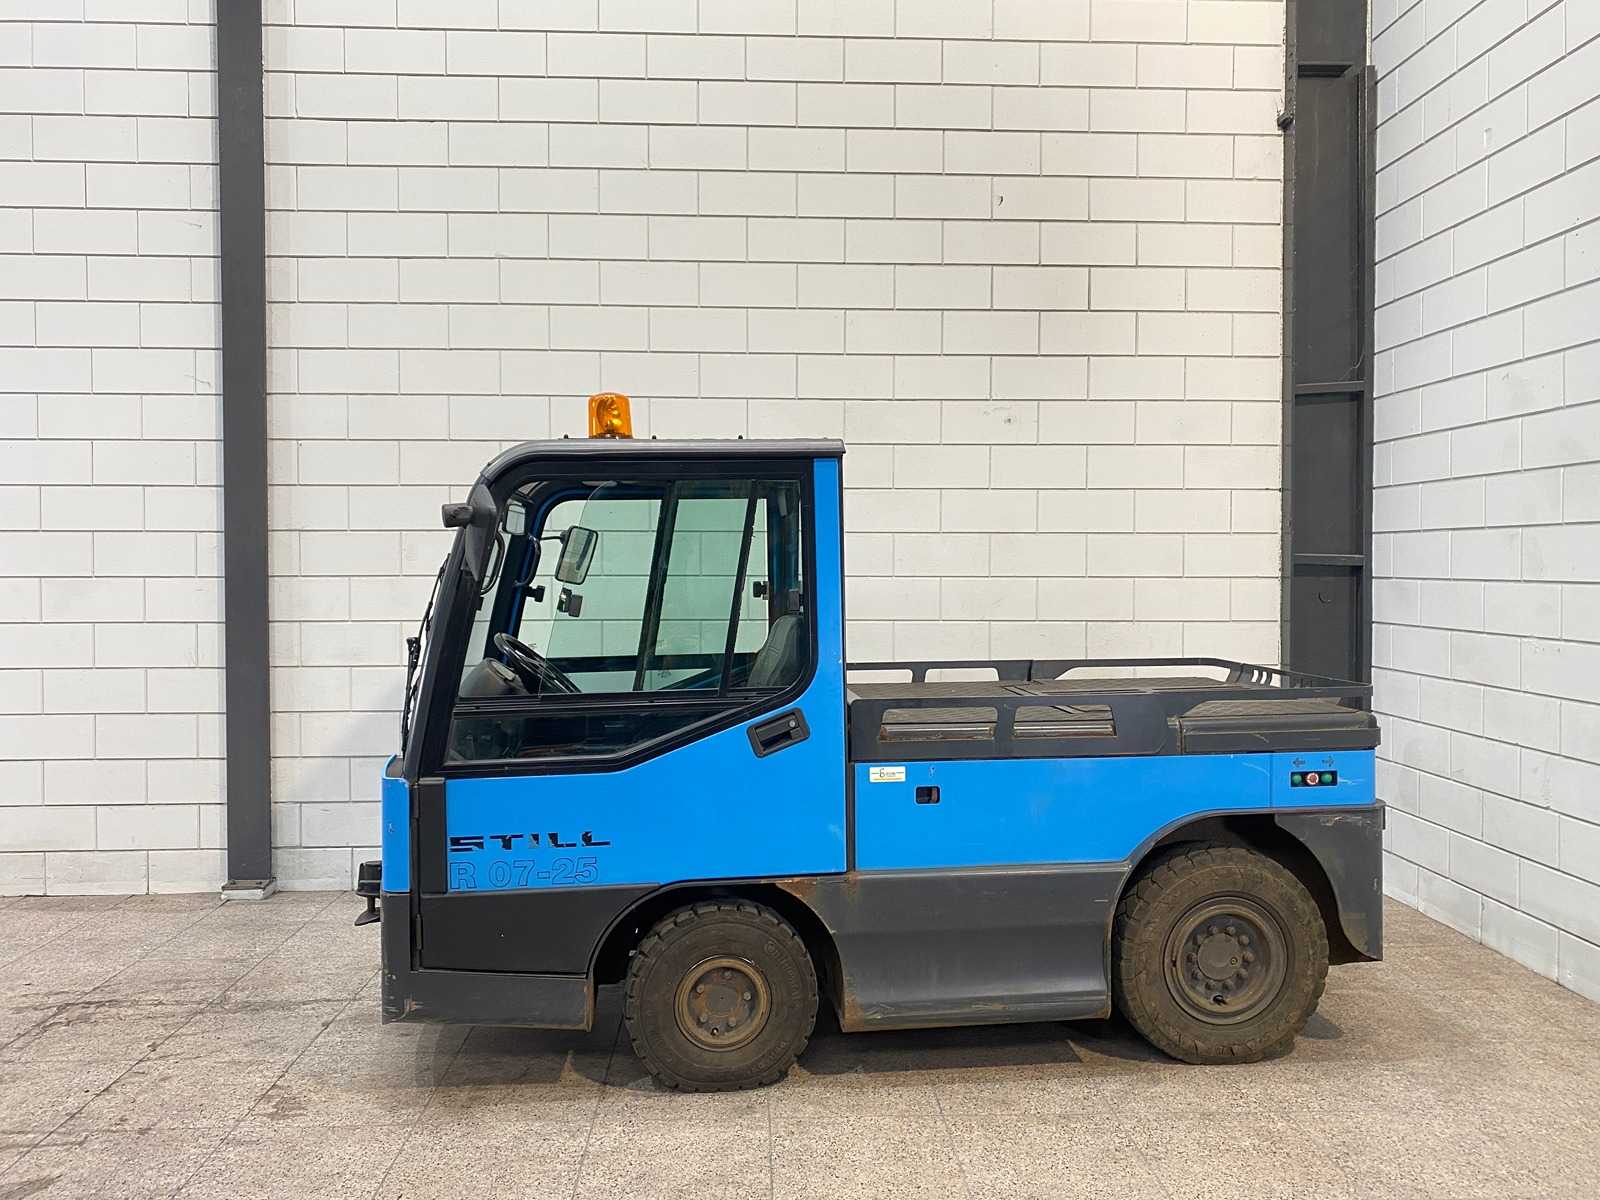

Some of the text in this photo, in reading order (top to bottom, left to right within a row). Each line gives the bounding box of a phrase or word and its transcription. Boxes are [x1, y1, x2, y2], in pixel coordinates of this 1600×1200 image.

[450, 831, 611, 852] STILL
[450, 856, 599, 889] R 07-25
